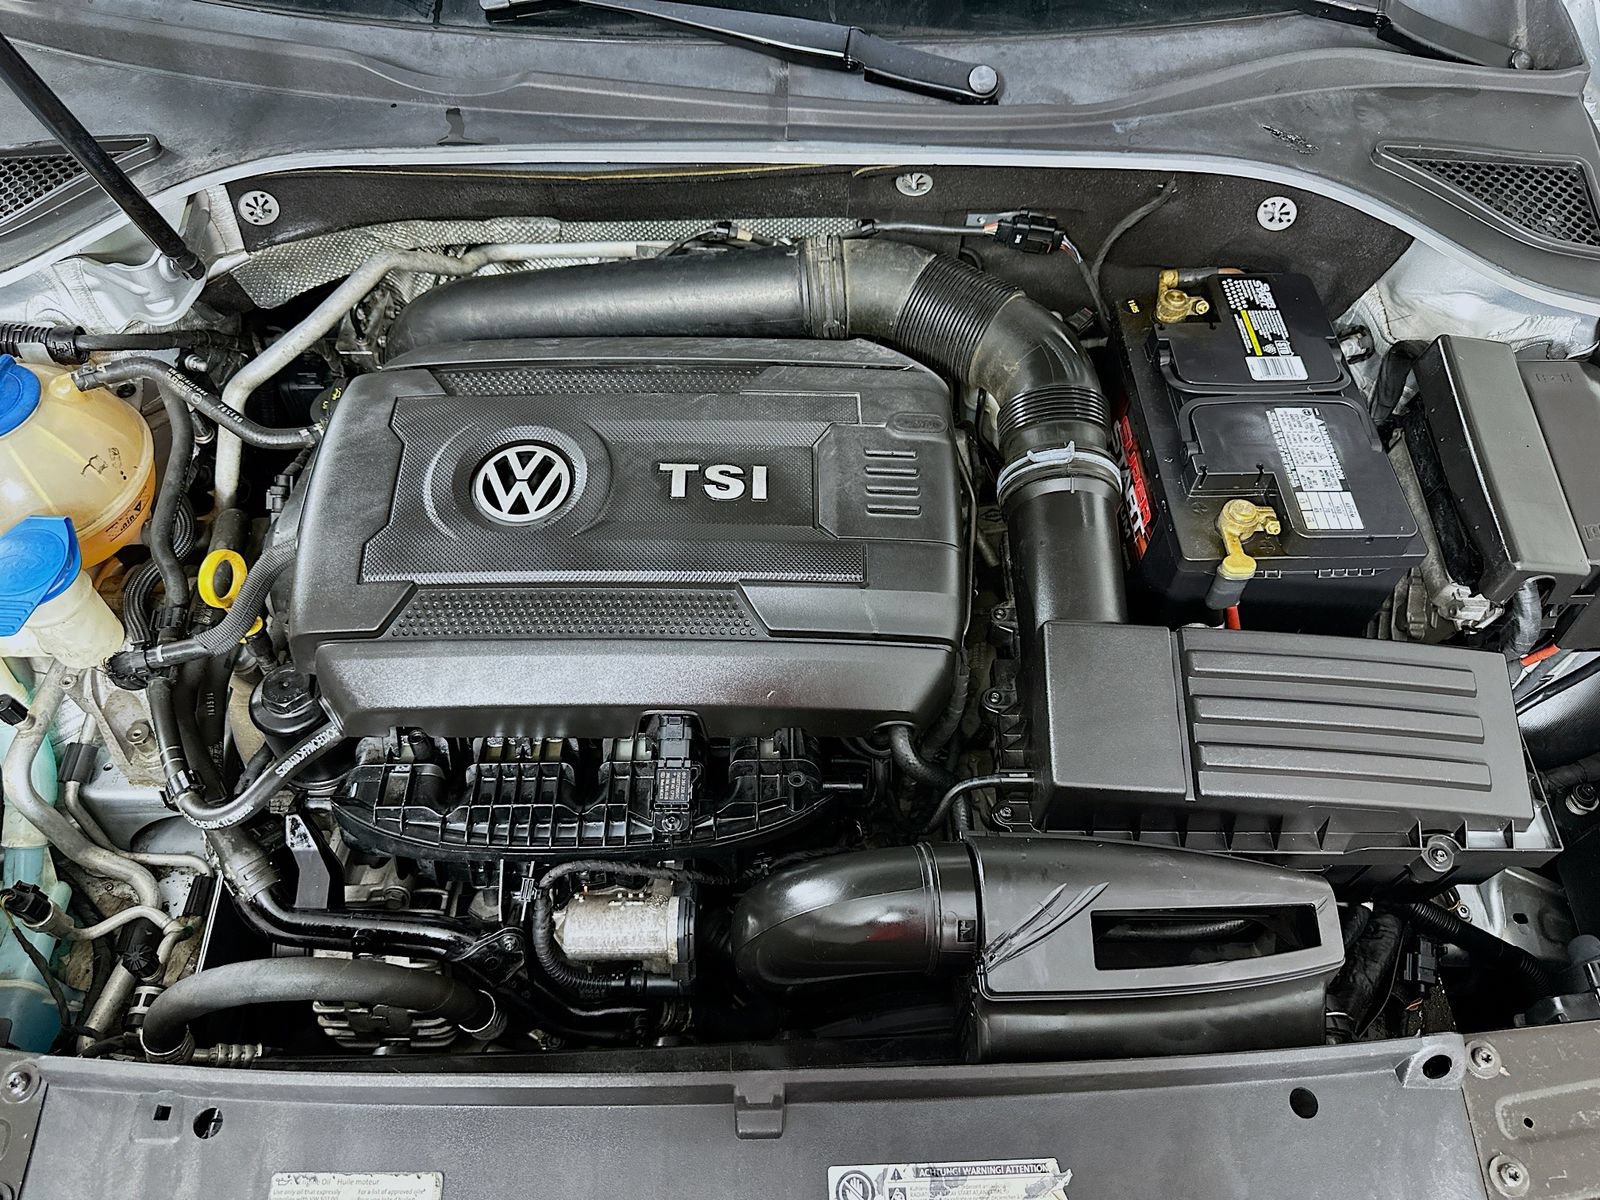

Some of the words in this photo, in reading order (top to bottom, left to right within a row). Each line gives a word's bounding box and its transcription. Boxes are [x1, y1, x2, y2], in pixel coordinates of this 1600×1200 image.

[659, 463, 767, 501] TSI
[1120, 415, 1151, 527] SUPER
[337, 1178, 355, 1186] Huile
[355, 1178, 380, 1186] moteur
[920, 1166, 961, 1177] ACHTUNG!
[962, 1164, 1004, 1175] WARNING!
